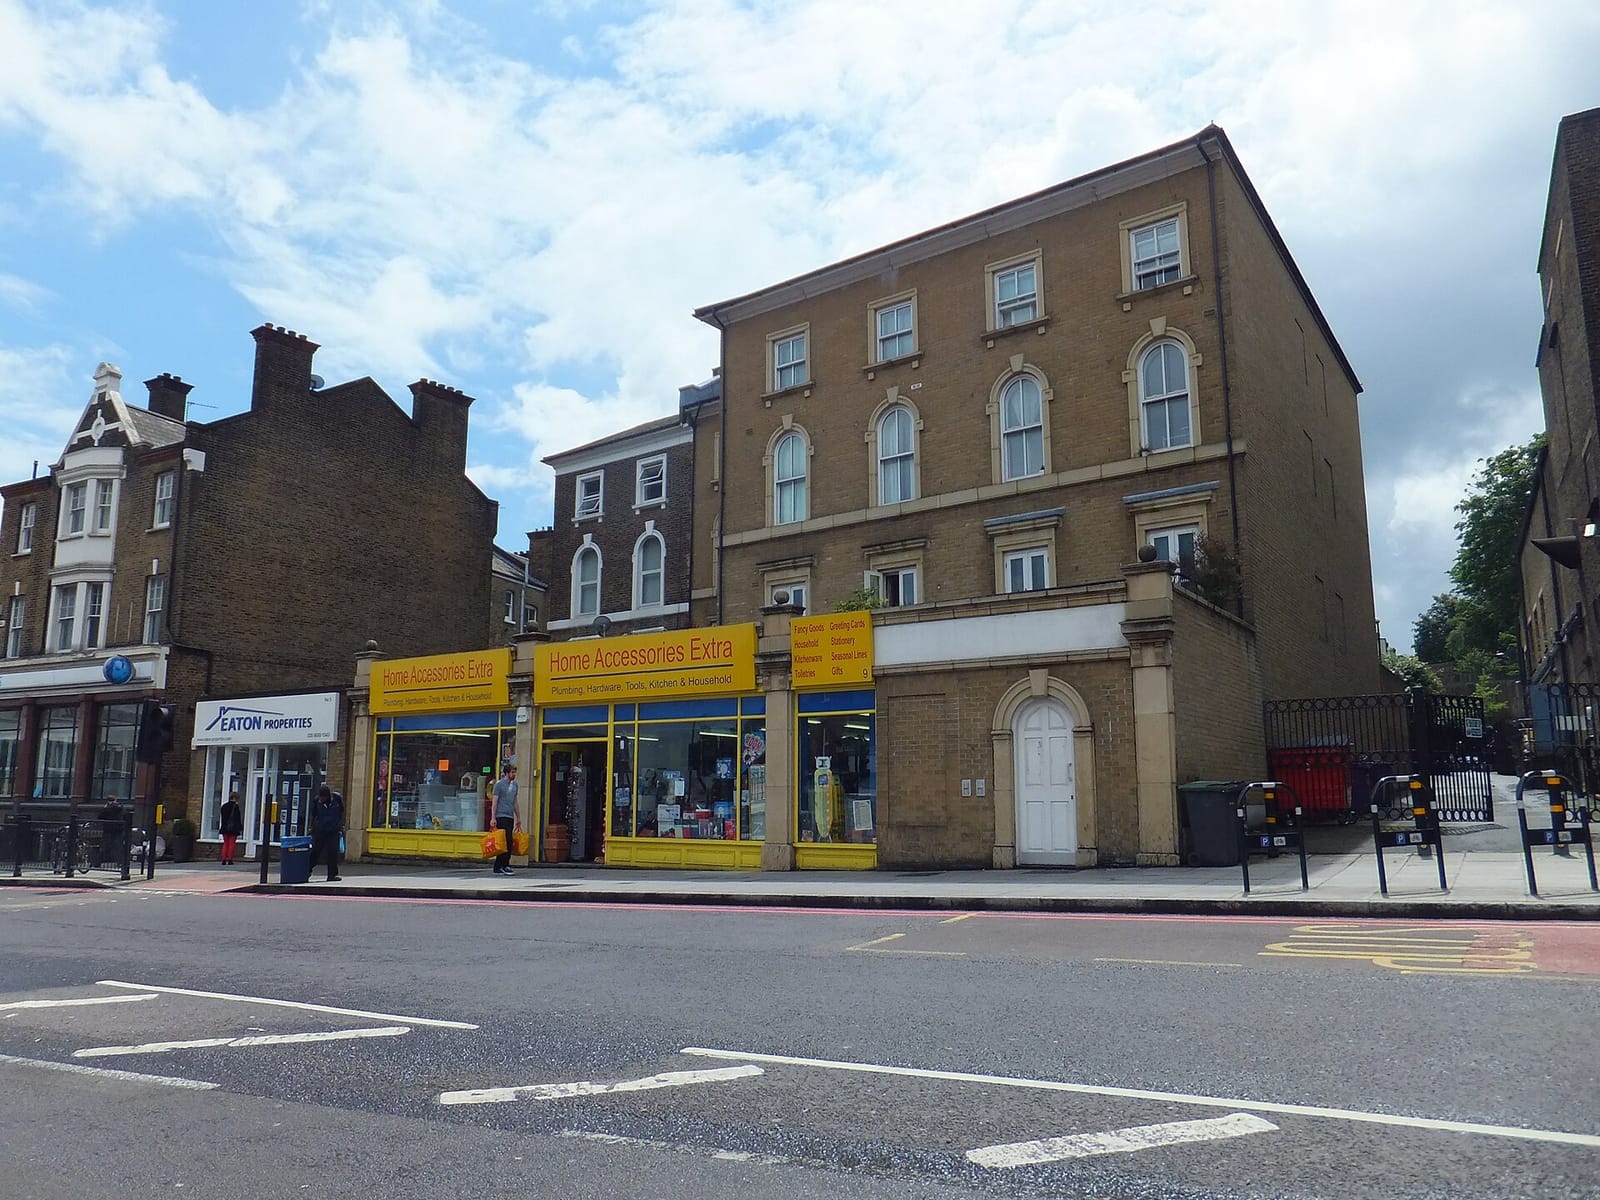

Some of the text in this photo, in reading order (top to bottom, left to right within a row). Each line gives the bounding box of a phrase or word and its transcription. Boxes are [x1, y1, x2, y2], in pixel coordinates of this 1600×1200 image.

[794, 624, 824, 635] Fancy Goods
[850, 620, 866, 629] Cards
[550, 637, 733, 672] Home Accessories Extra
[384, 660, 493, 686] Home Accessories Extra
[862, 668, 868, 678] 9
[552, 674, 732, 696] Plumbing, Hardware, Tools, Kitchen & Household
[220, 716, 312, 732] EATON PROPERTIES
